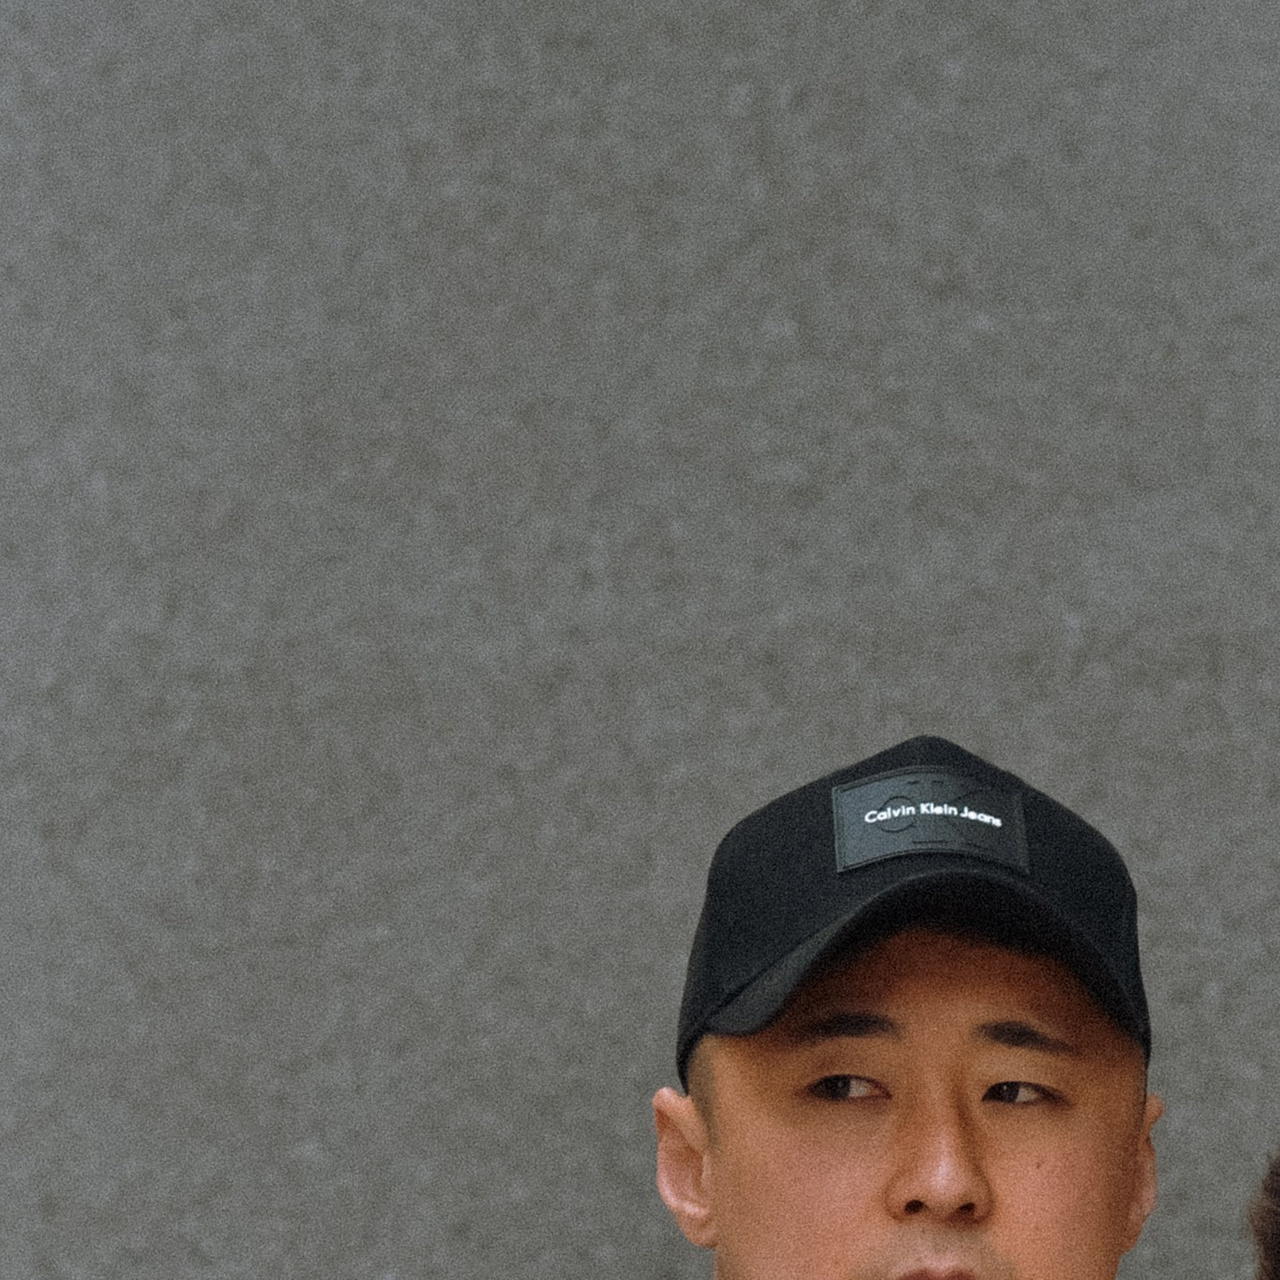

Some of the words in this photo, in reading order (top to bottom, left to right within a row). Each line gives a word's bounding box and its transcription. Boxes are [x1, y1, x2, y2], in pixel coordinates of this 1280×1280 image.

[864, 805, 915, 823] Calvin
[919, 803, 958, 816] Klein
[960, 807, 1002, 827] Jeans
